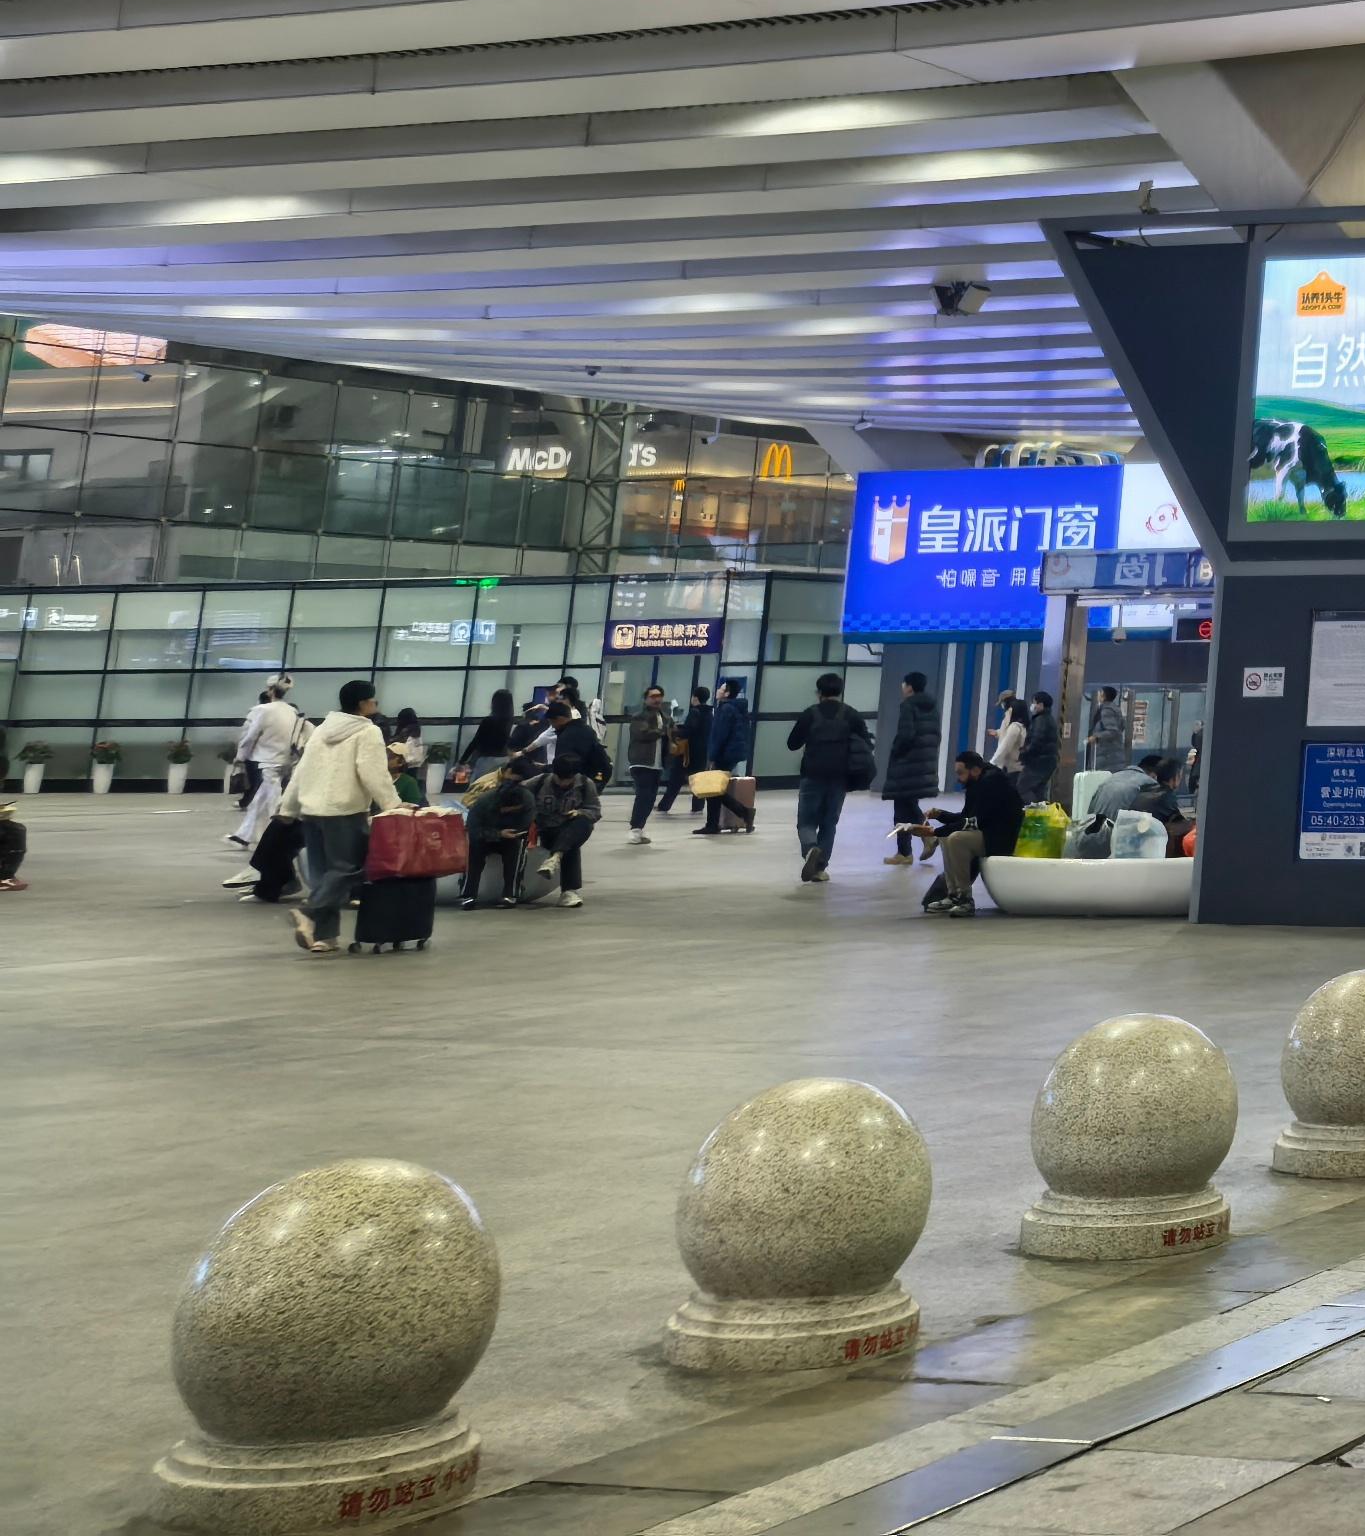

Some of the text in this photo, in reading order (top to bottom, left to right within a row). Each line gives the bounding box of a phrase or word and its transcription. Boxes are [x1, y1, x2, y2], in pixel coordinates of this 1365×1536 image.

[918, 505, 1099, 554] 皇派门窗
[1321, 786, 1365, 799] 营业时间
[1161, 1221, 1217, 1247] 请勿站立
[843, 1327, 906, 1361] 请勿站立
